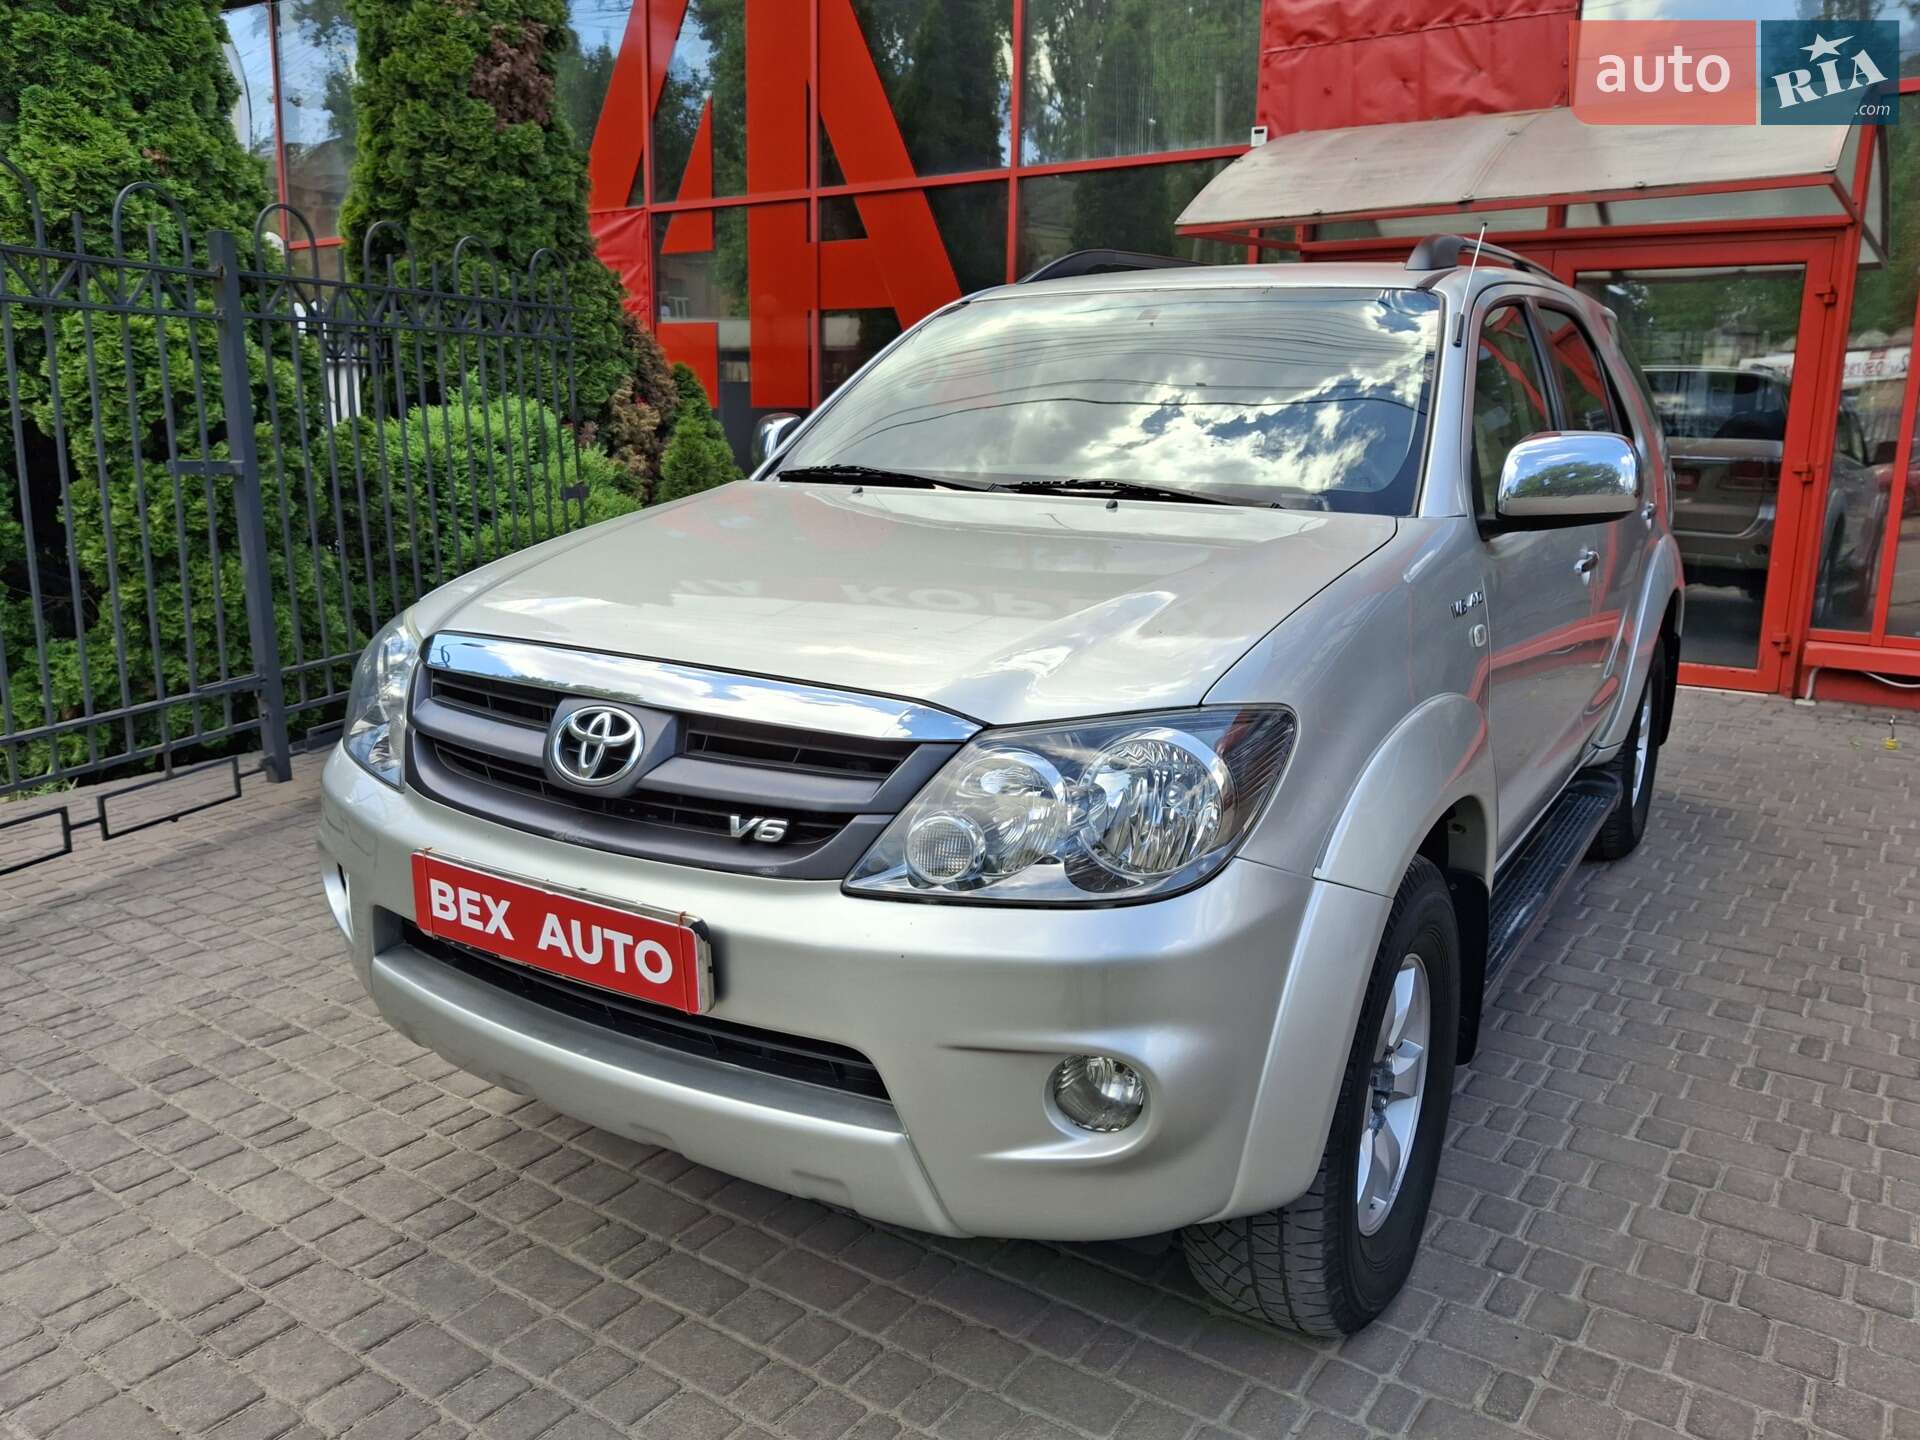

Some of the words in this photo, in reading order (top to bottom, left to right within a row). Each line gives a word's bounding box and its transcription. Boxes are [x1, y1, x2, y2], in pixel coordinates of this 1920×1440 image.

[730, 814, 788, 842] V6
[429, 878, 515, 941] BEX
[537, 912, 673, 984] AUTO
